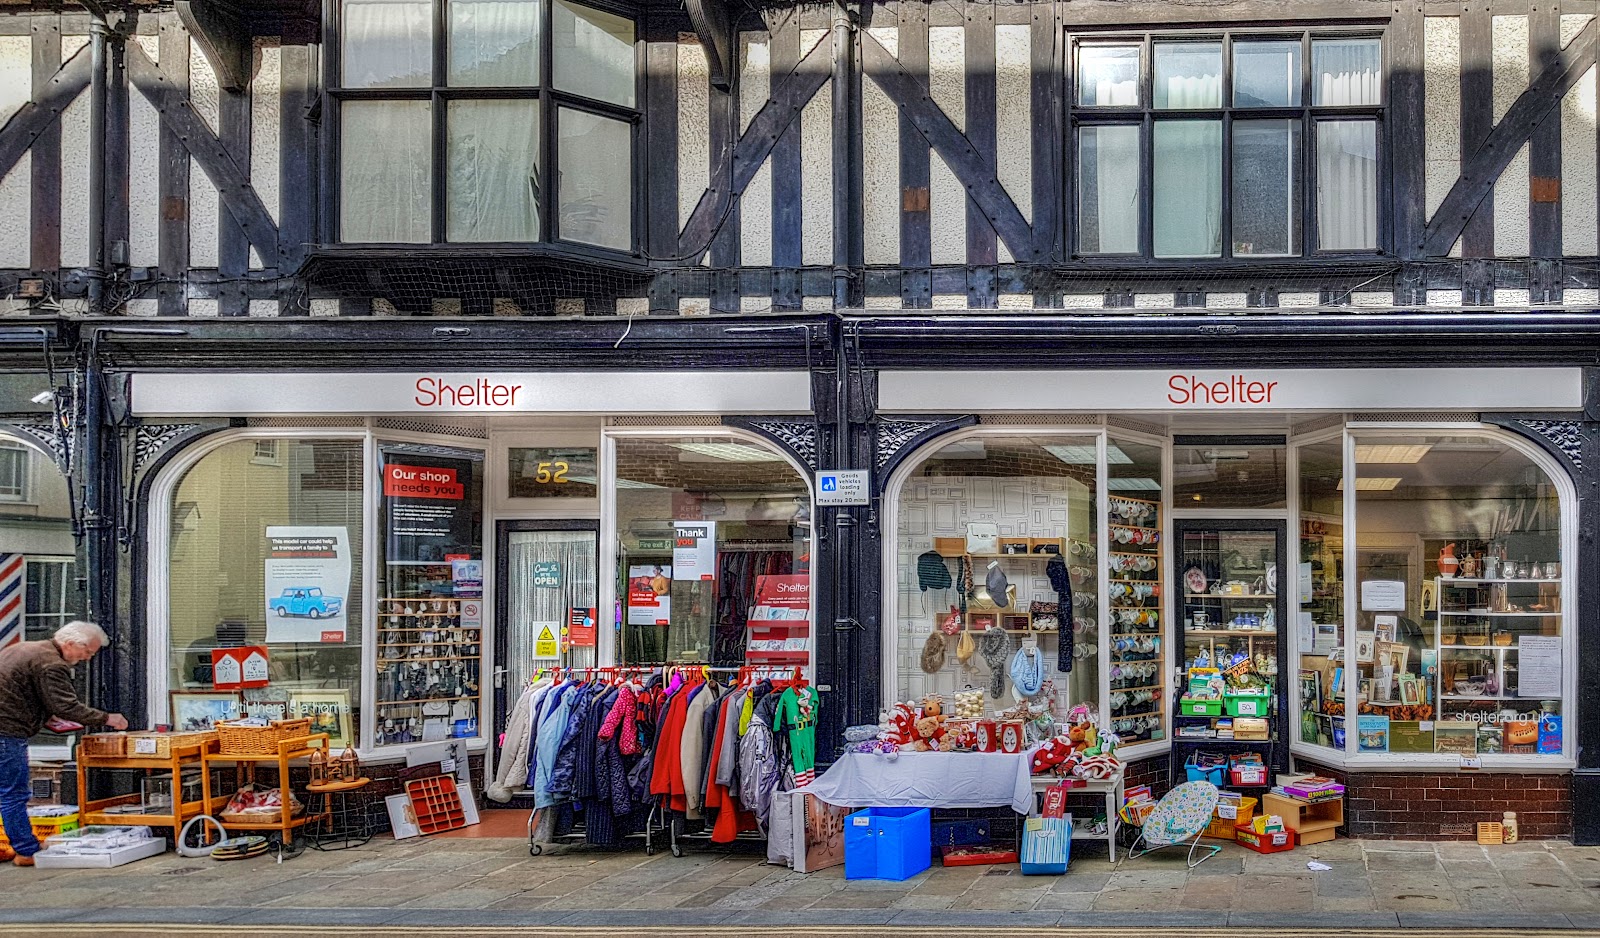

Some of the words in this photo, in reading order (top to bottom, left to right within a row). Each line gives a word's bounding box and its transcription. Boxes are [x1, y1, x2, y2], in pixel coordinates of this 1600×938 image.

[414, 377, 522, 407] Shelter
[1167, 374, 1278, 404] Shelter
[392, 468, 416, 480] Our
[420, 470, 450, 484] shop
[535, 461, 570, 484] 52
[392, 483, 431, 493] needs
[434, 485, 457, 496] you
[676, 528, 704, 537] Thank
[677, 538, 693, 547] you
[534, 564, 548, 573] Come
[550, 564, 558, 572] In
[534, 577, 558, 585] OPEN
[776, 582, 809, 593] Shelter
[220, 700, 248, 714] Until
[253, 701, 286, 714] there
[301, 704, 309, 714] a
[312, 701, 350, 714] home
[1455, 709, 1550, 726] shelter.org.uk
